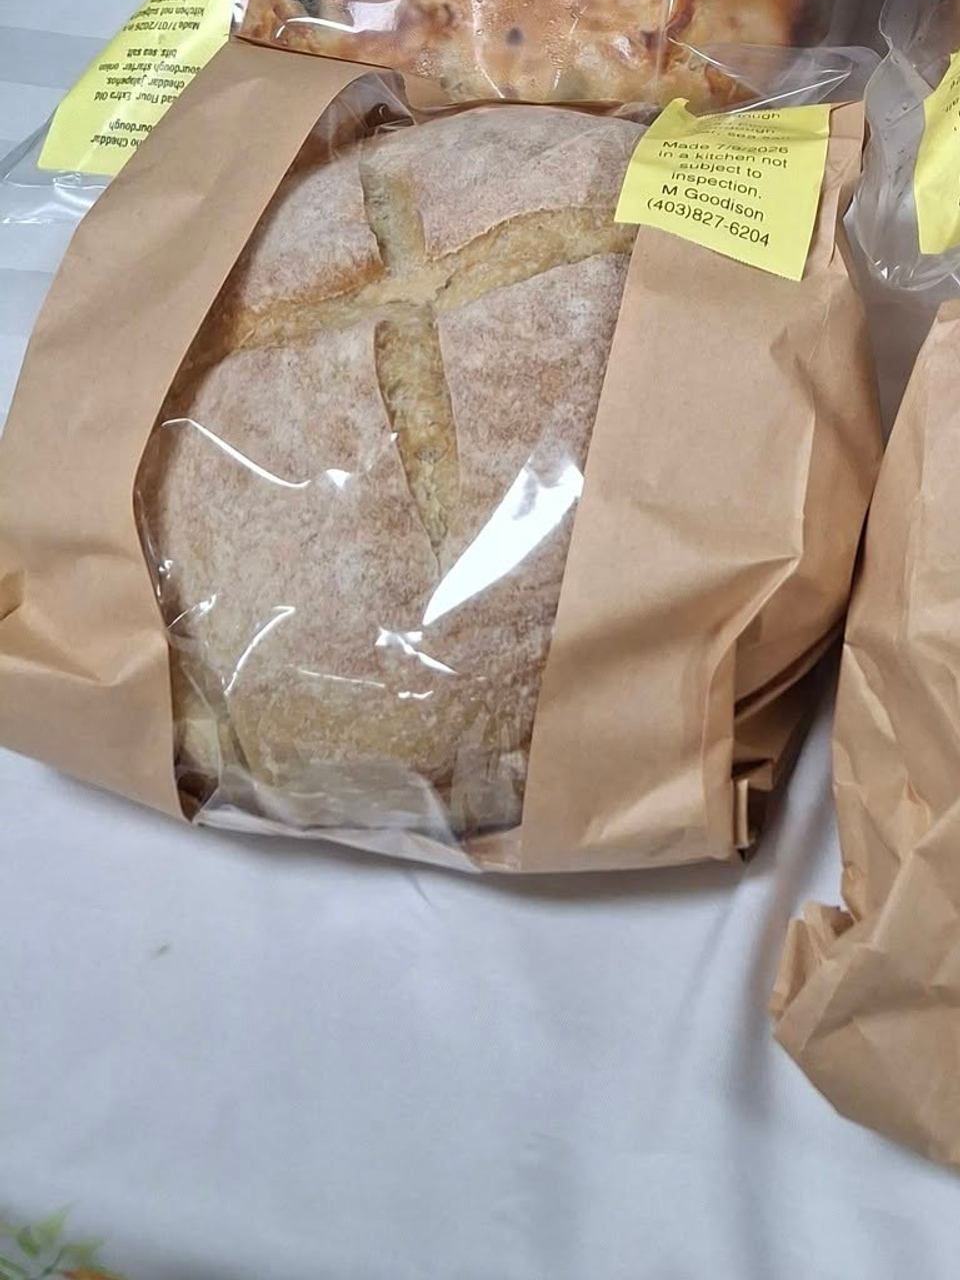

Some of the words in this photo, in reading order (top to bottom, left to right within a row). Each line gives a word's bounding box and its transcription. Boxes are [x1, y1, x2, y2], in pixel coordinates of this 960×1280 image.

[160, 7, 174, 16] not
[175, 7, 205, 17] kitchen
[178, 21, 200, 31] Made
[94, 91, 108, 101] Old
[109, 119, 153, 133] ourdough
[90, 135, 128, 148] Cheddar
[662, 141, 710, 150] Made
[658, 150, 673, 158] in
[695, 151, 756, 163] kitchen
[761, 156, 788, 169] not
[679, 161, 741, 176] subject
[746, 165, 763, 179] to
[671, 171, 763, 199] inspection.
[661, 184, 678, 196] M
[684, 188, 764, 221] Goodison
[646, 197, 771, 248] (403)827-6204
